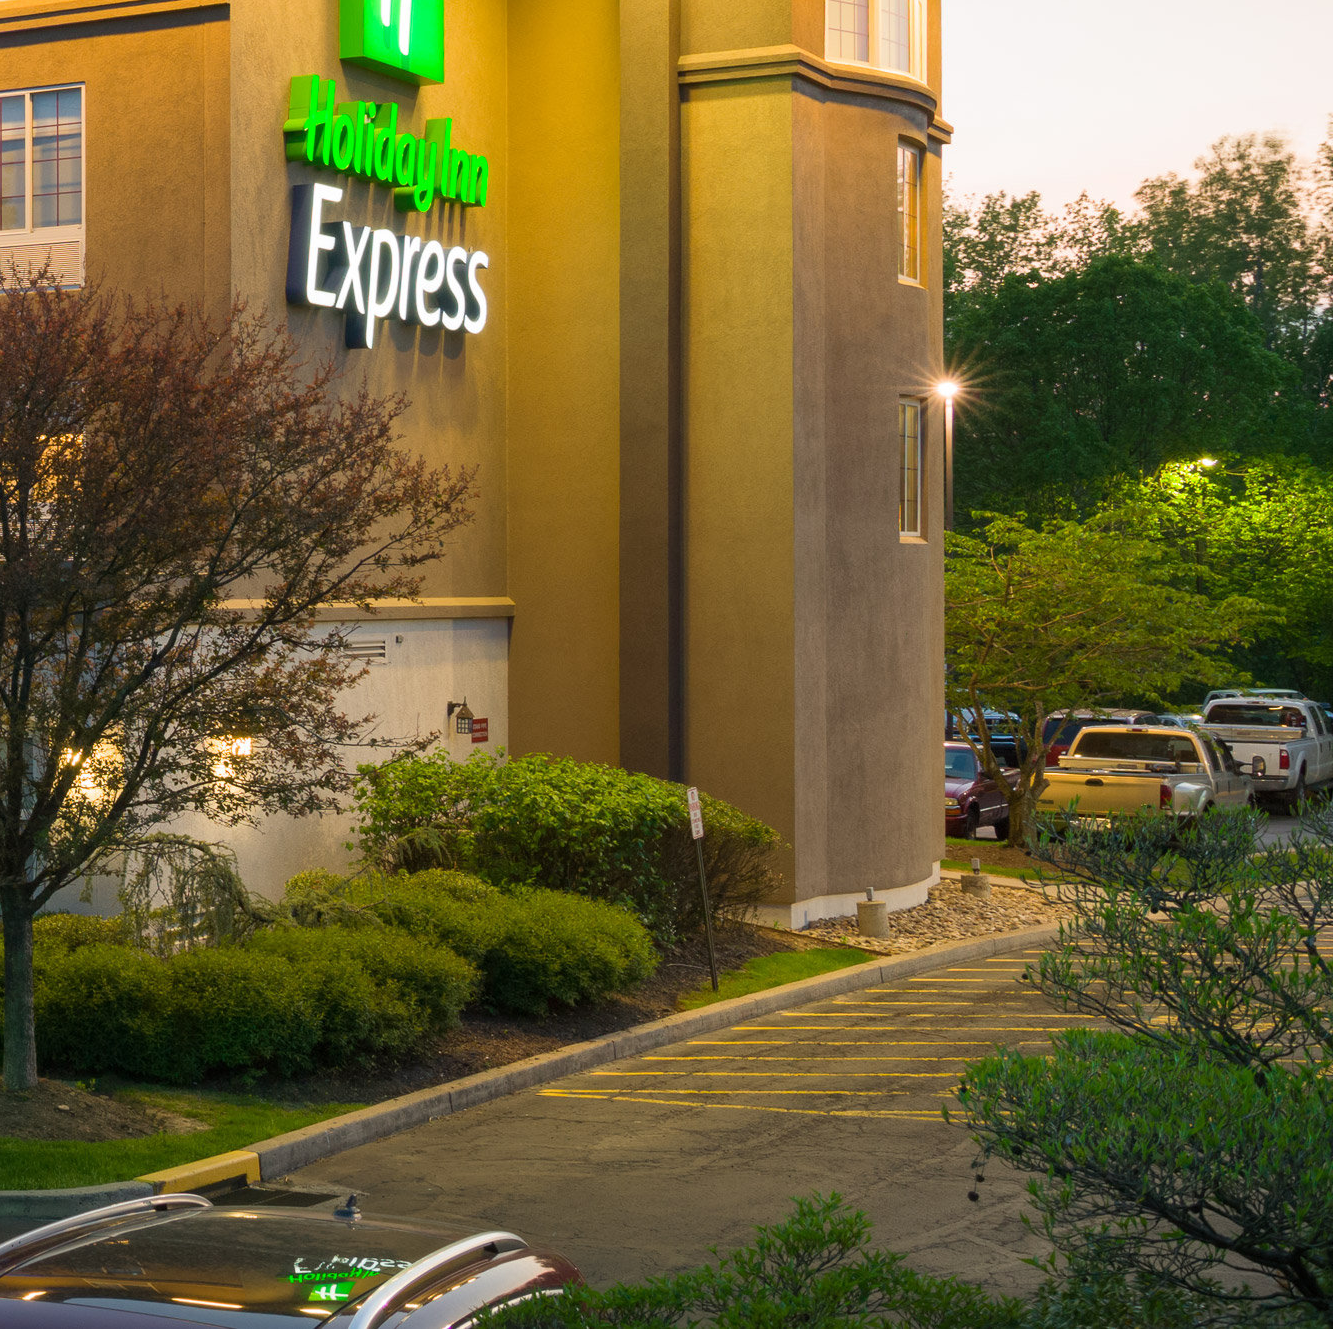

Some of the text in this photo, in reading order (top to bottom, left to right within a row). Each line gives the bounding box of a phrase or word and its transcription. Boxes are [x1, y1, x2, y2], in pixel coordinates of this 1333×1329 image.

[284, 74, 489, 213] Holiday Inn
[303, 182, 489, 350] Express
